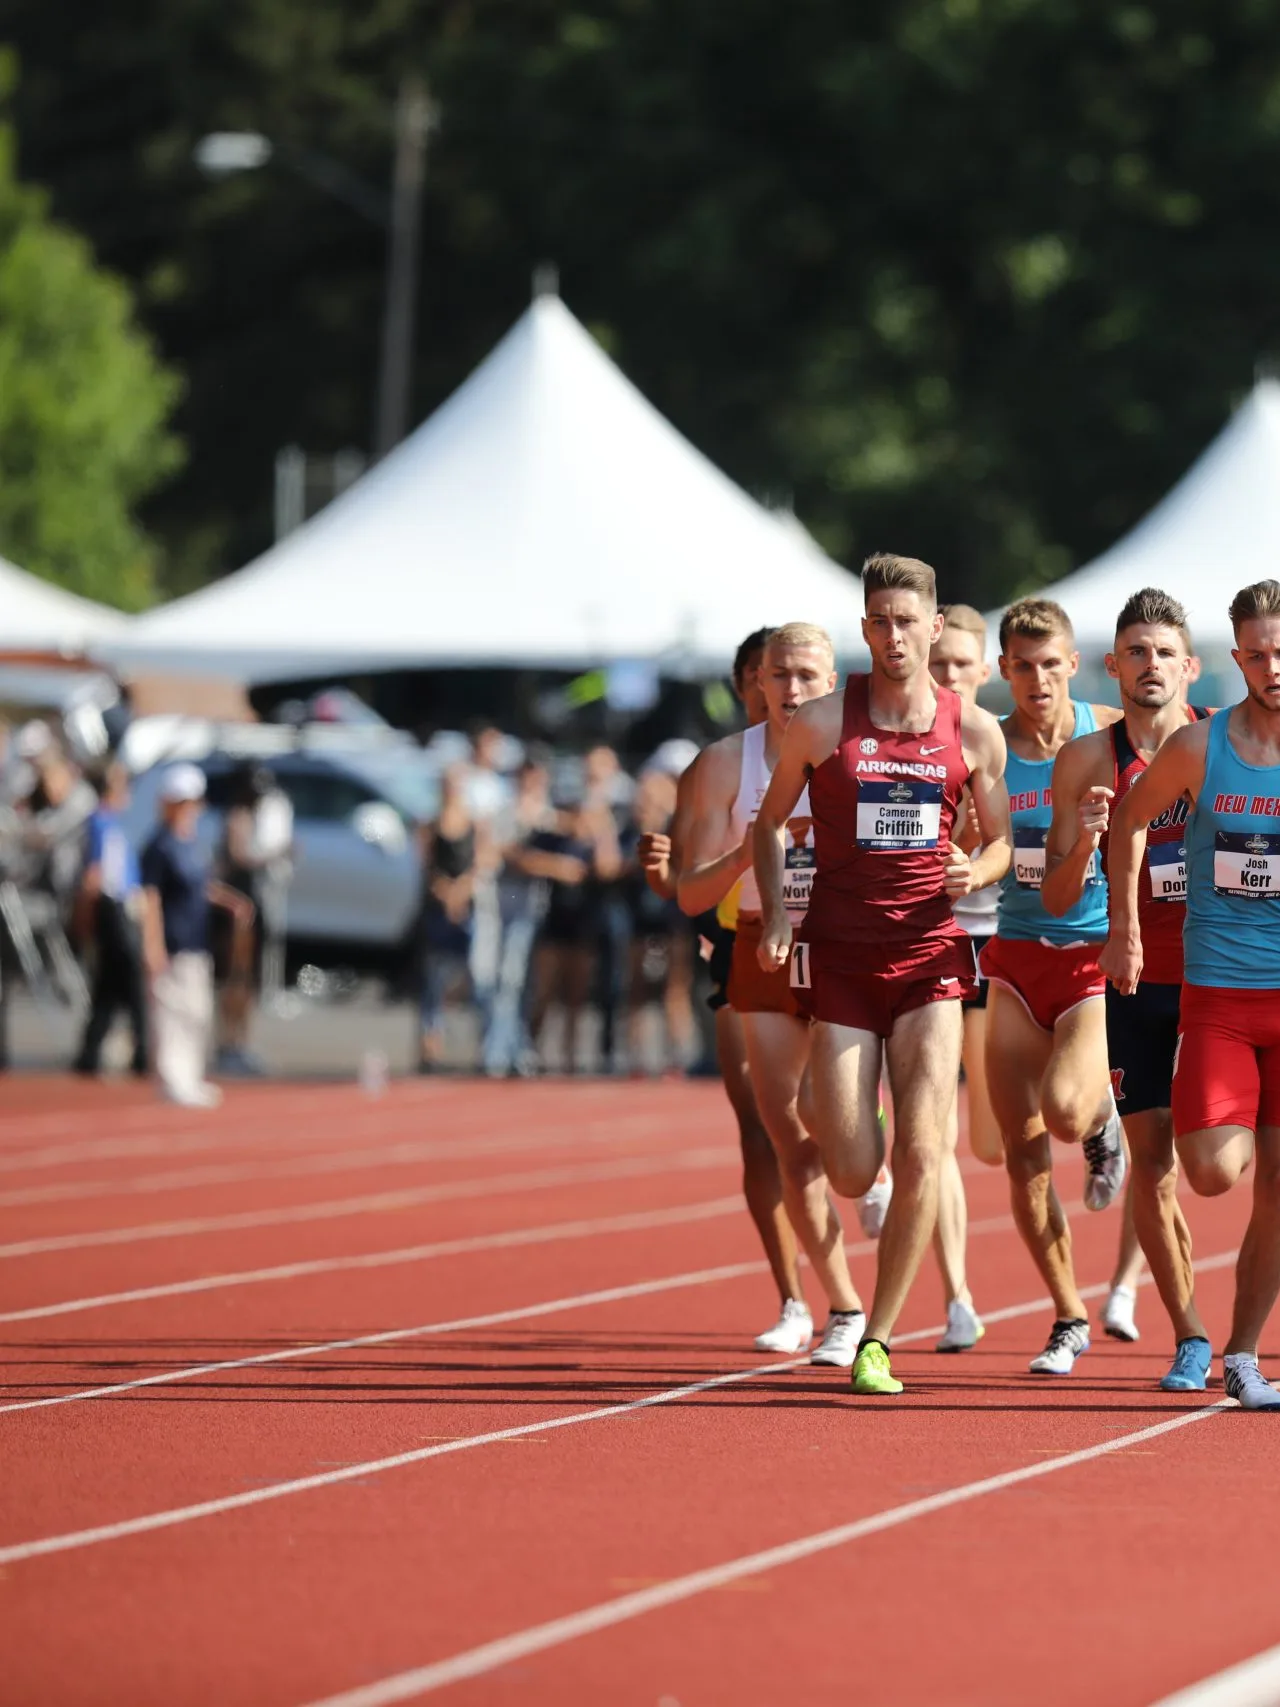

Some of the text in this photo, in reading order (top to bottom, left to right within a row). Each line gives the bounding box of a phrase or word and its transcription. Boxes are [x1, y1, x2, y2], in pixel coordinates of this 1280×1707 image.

[861, 741, 877, 755] SEC
[856, 760, 947, 779] ARKANSAS
[1009, 790, 1038, 813] NEW
[1213, 792, 1248, 814] NEW
[879, 807, 921, 818] Cameron
[874, 820, 923, 836] Griffith
[1245, 858, 1268, 869] Josh
[792, 872, 812, 882] Sam
[1240, 870, 1272, 887] Kerr
[793, 945, 804, 985] 1
